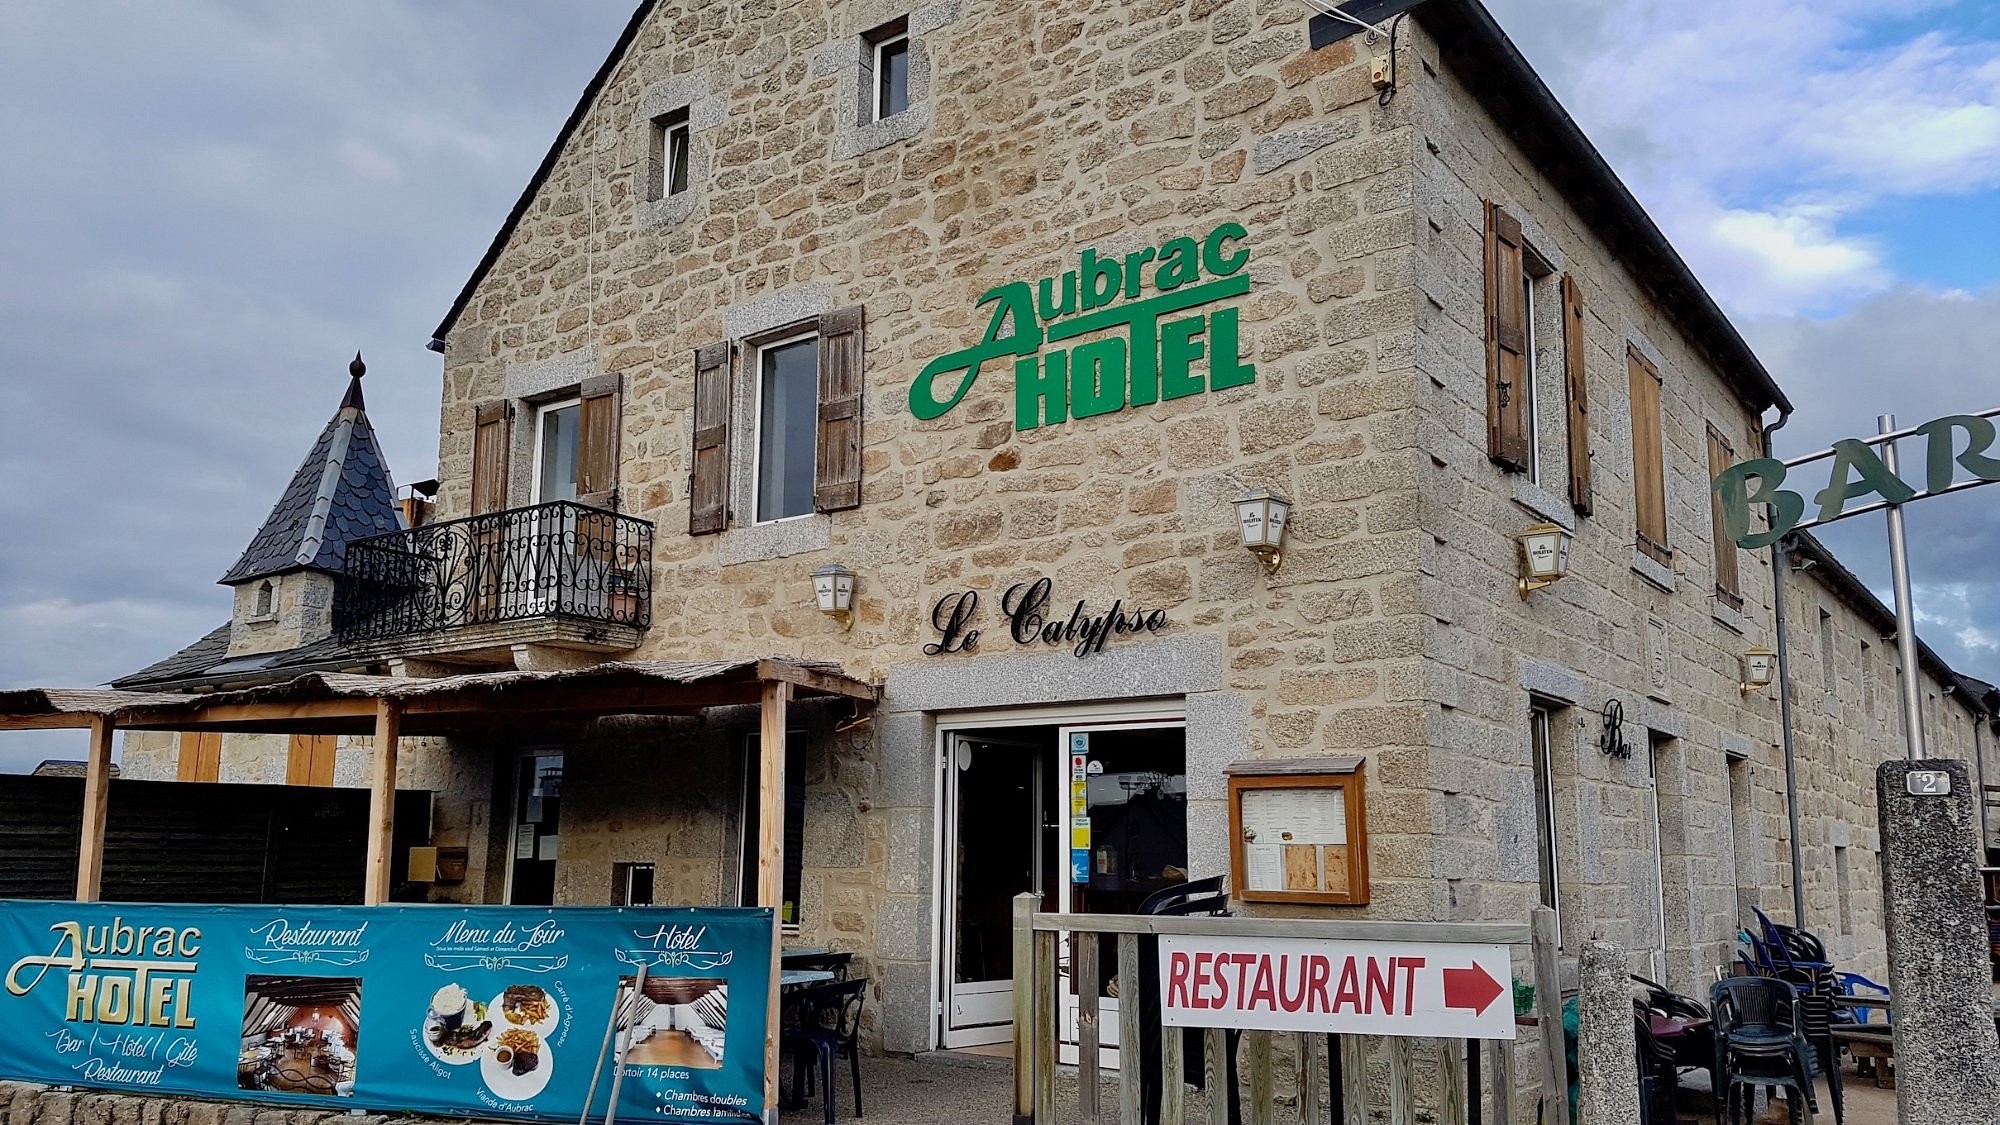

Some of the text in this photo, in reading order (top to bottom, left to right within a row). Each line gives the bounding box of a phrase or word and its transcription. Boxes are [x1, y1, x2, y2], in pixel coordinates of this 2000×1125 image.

[908, 222, 1251, 420] Aubrac
[1015, 273, 1255, 432] HOTEL
[1711, 414, 2000, 549] BAR
[923, 577, 1166, 659] Le Calypso
[1600, 698, 1631, 761] Bar
[1921, 773, 1937, 793] 2
[250, 918, 369, 950] Restaurant
[430, 919, 565, 952] Menu du Jour
[633, 924, 707, 950] Hôtel
[5, 917, 201, 996] Aubrac
[65, 958, 198, 1027] HOTEL
[1167, 951, 1426, 1016] RESTAURANT
[45, 1028, 85, 1054] Bar
[409, 1028, 452, 1079] Saucisse Aligot
[71, 1057, 165, 1085] Restaurant
[646, 1067, 658, 1078] 14
[659, 1067, 690, 1081] places
[476, 1087, 534, 1112] Viande d'Aubrac
[663, 1104, 710, 1118] Chambres
[664, 1089, 748, 1106] Chambres doubles
